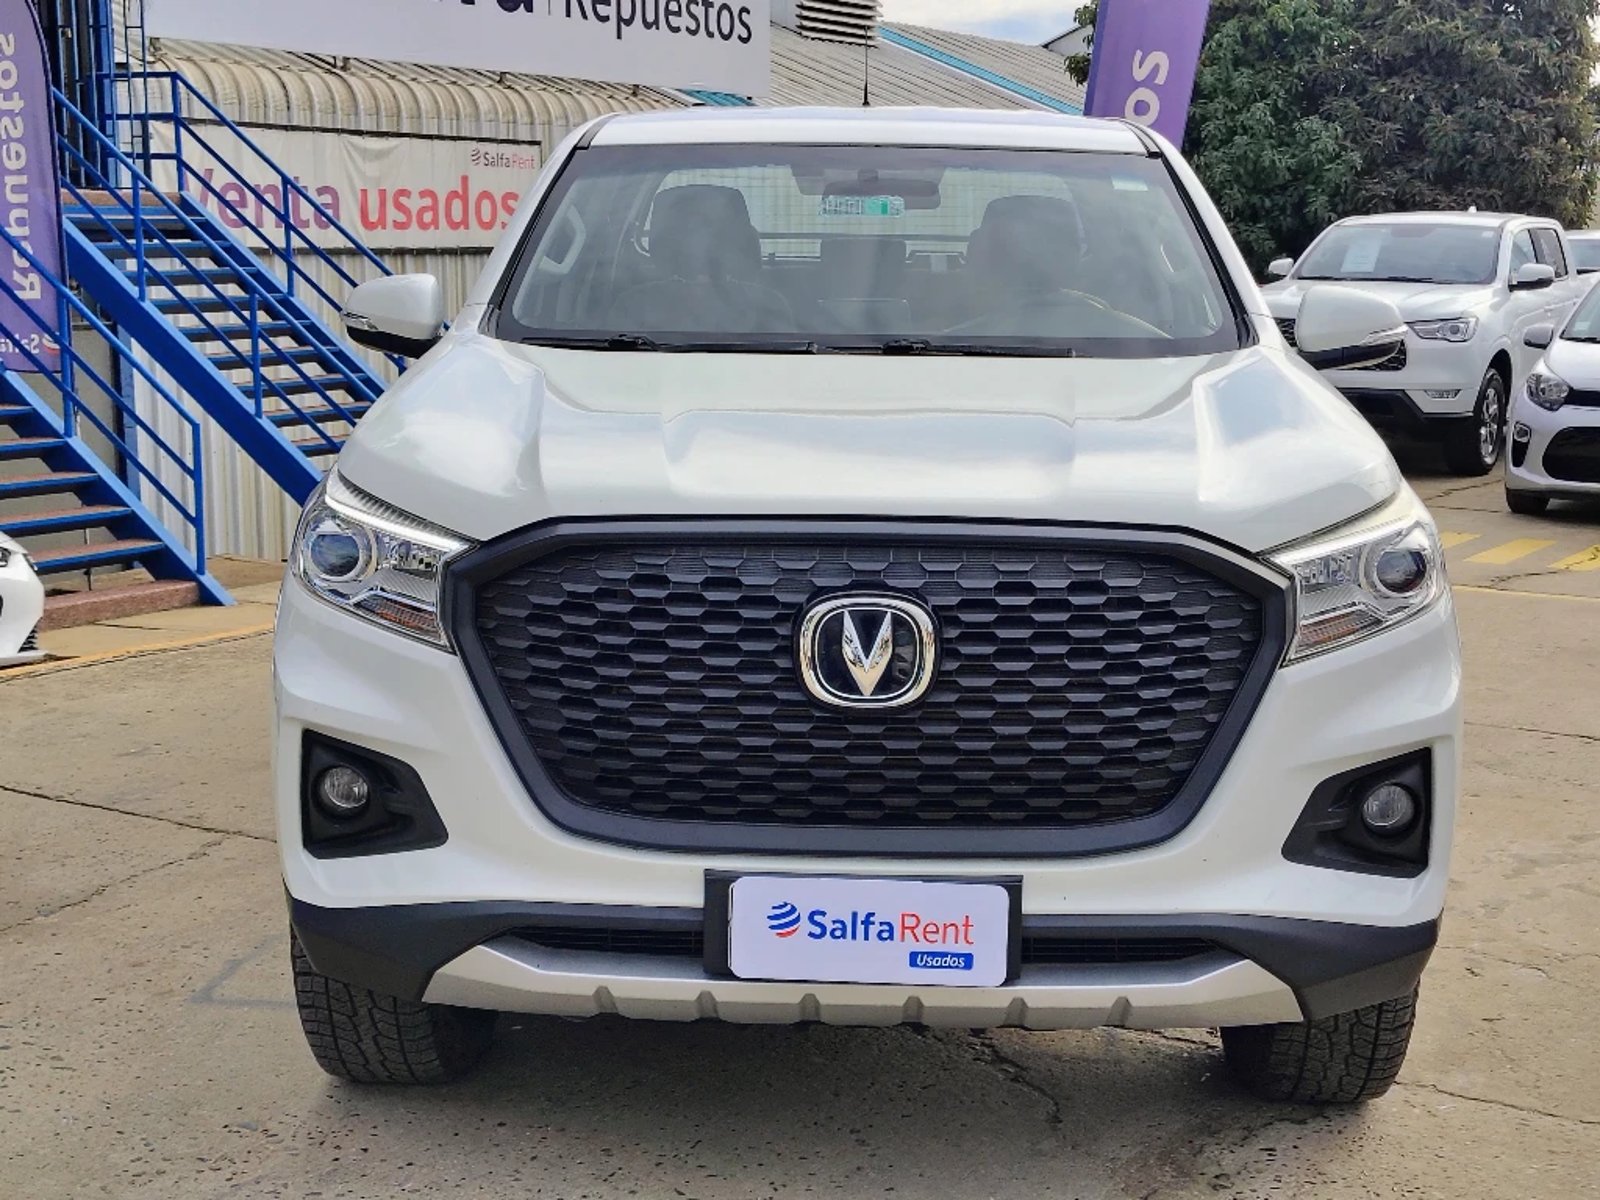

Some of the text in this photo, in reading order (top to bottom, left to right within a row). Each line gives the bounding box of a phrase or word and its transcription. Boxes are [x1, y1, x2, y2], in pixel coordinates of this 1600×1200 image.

[483, 151, 535, 169] SalfaRent
[360, 174, 519, 231] usados
[807, 909, 975, 945] SalfaRent
[916, 953, 965, 968] Usados
